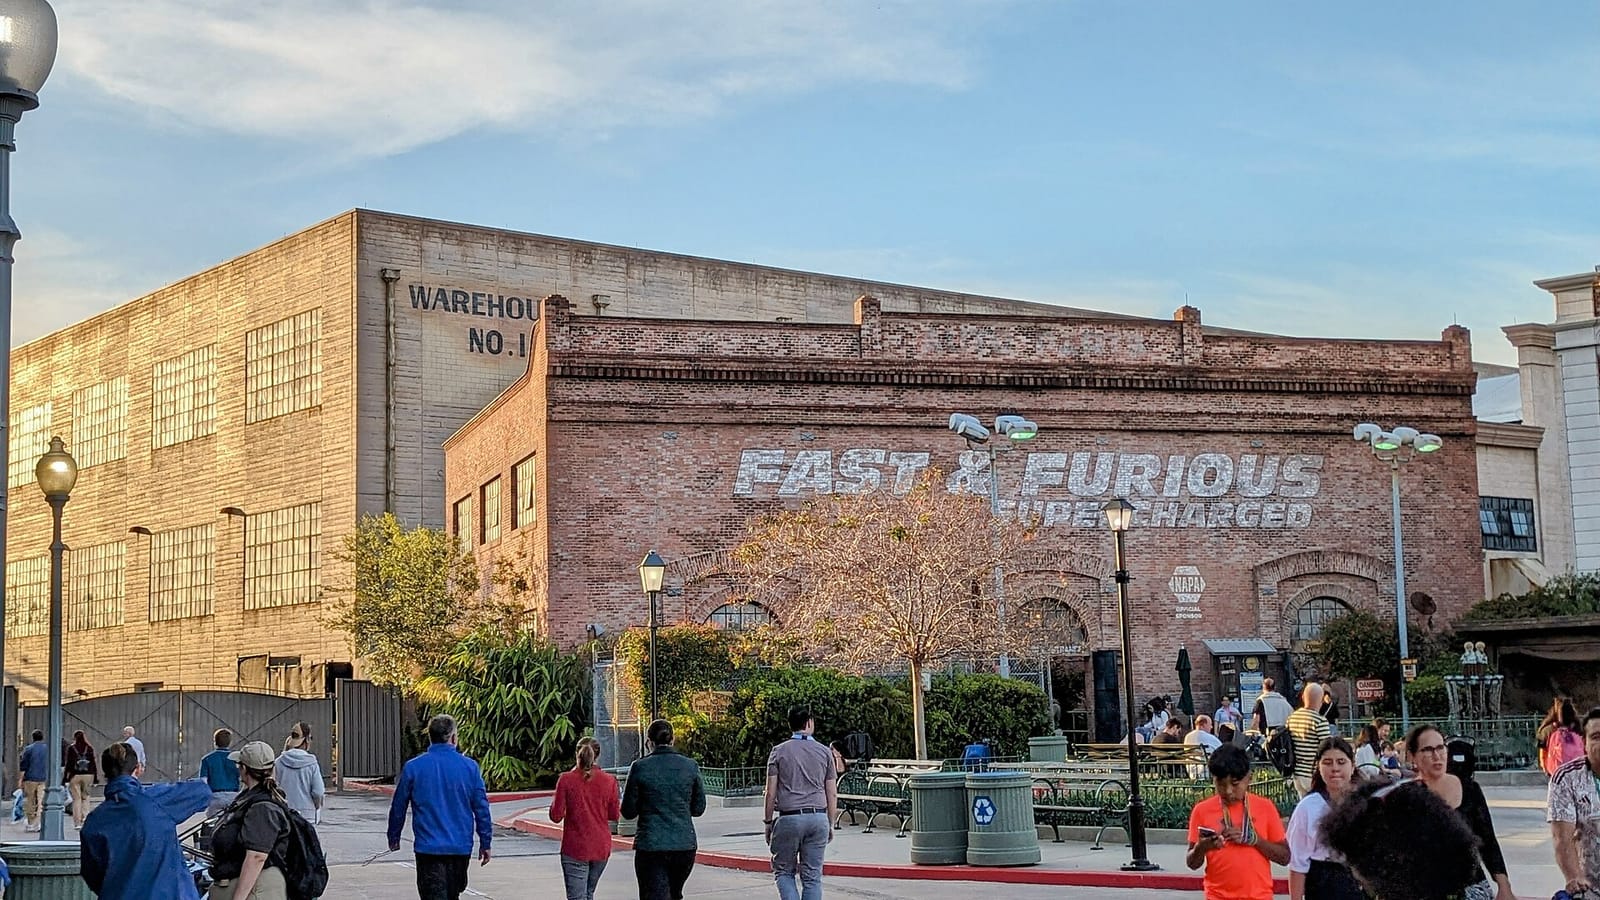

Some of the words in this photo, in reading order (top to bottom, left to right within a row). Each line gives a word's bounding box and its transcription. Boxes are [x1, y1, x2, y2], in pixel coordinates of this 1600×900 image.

[409, 285, 541, 321] WAREHOU
[733, 449, 930, 495] FAST
[946, 449, 992, 495] &
[1020, 451, 1325, 498] FURIOUS
[1174, 576, 1201, 592] NAPA
